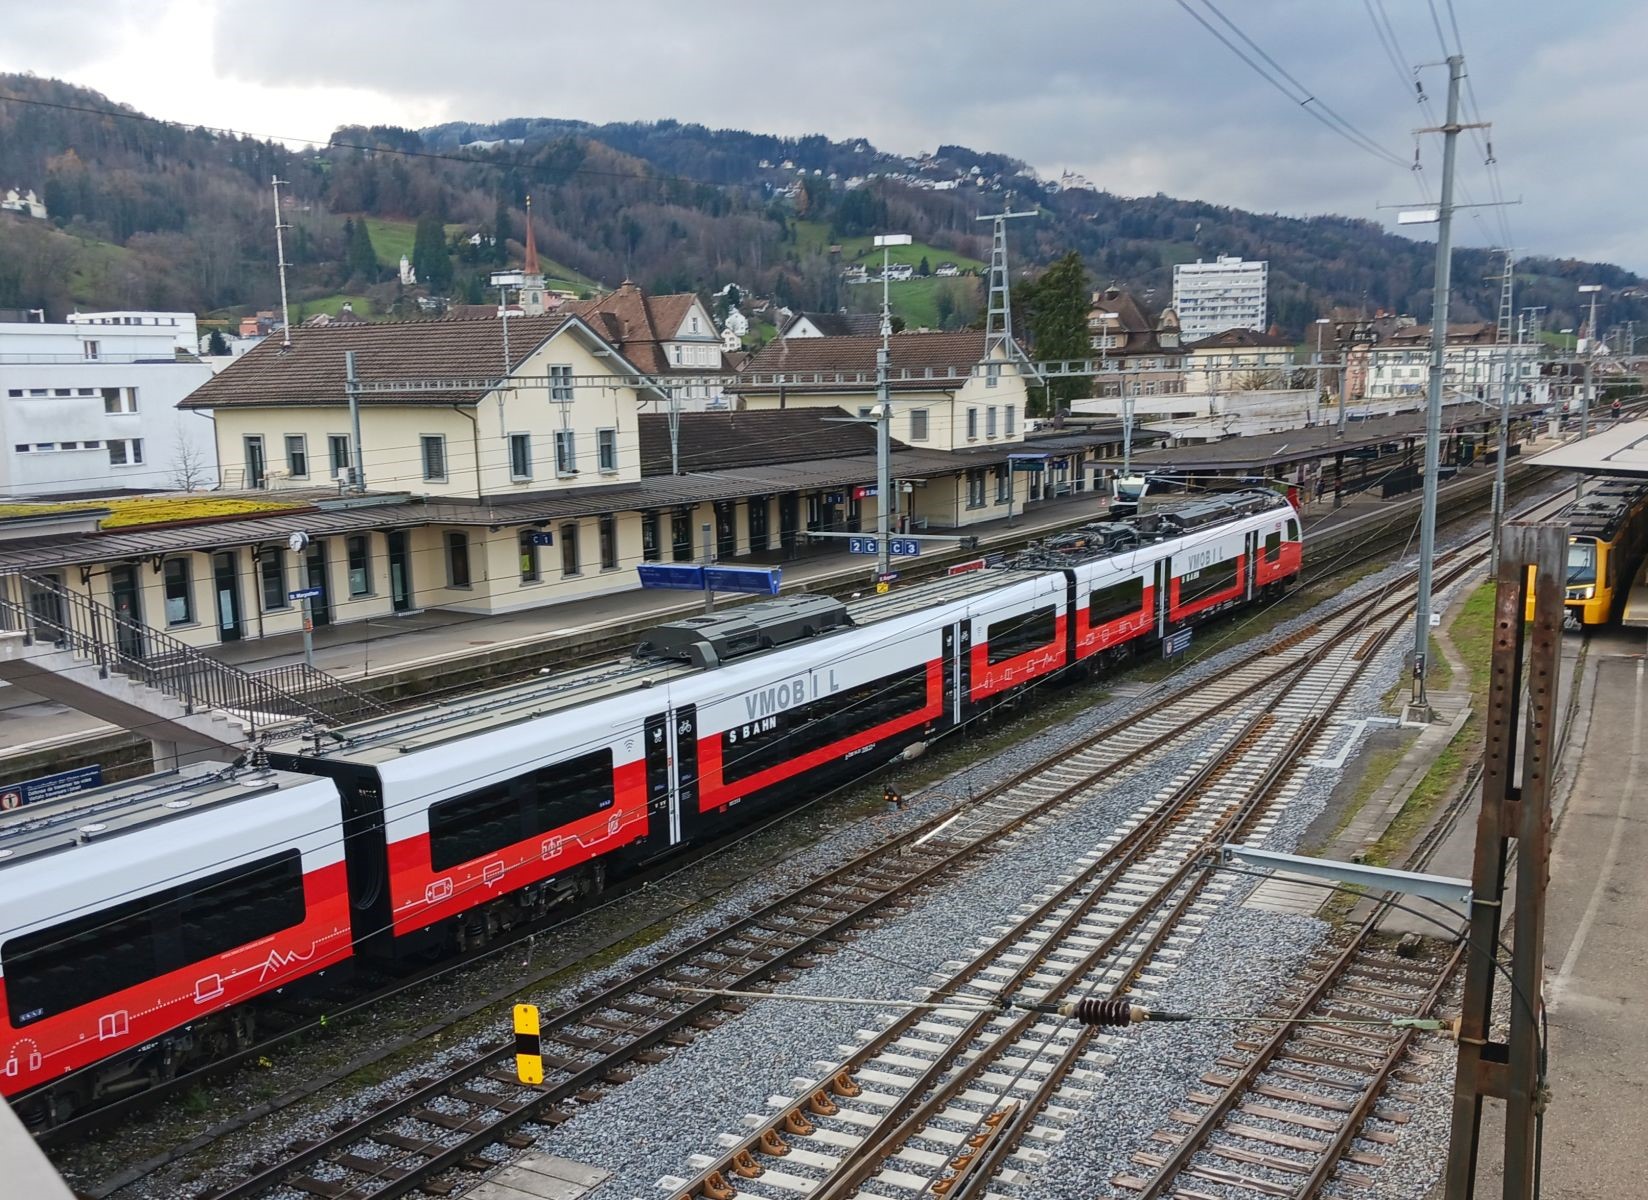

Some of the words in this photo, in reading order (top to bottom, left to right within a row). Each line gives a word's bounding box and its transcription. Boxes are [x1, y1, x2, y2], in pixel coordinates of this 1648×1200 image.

[533, 536, 539, 544] C
[853, 542, 861, 551] 2
[867, 543, 875, 552] C
[893, 544, 901, 553] C
[908, 544, 916, 553] 3
[729, 730, 737, 743] S
[742, 716, 777, 739] BAHN
